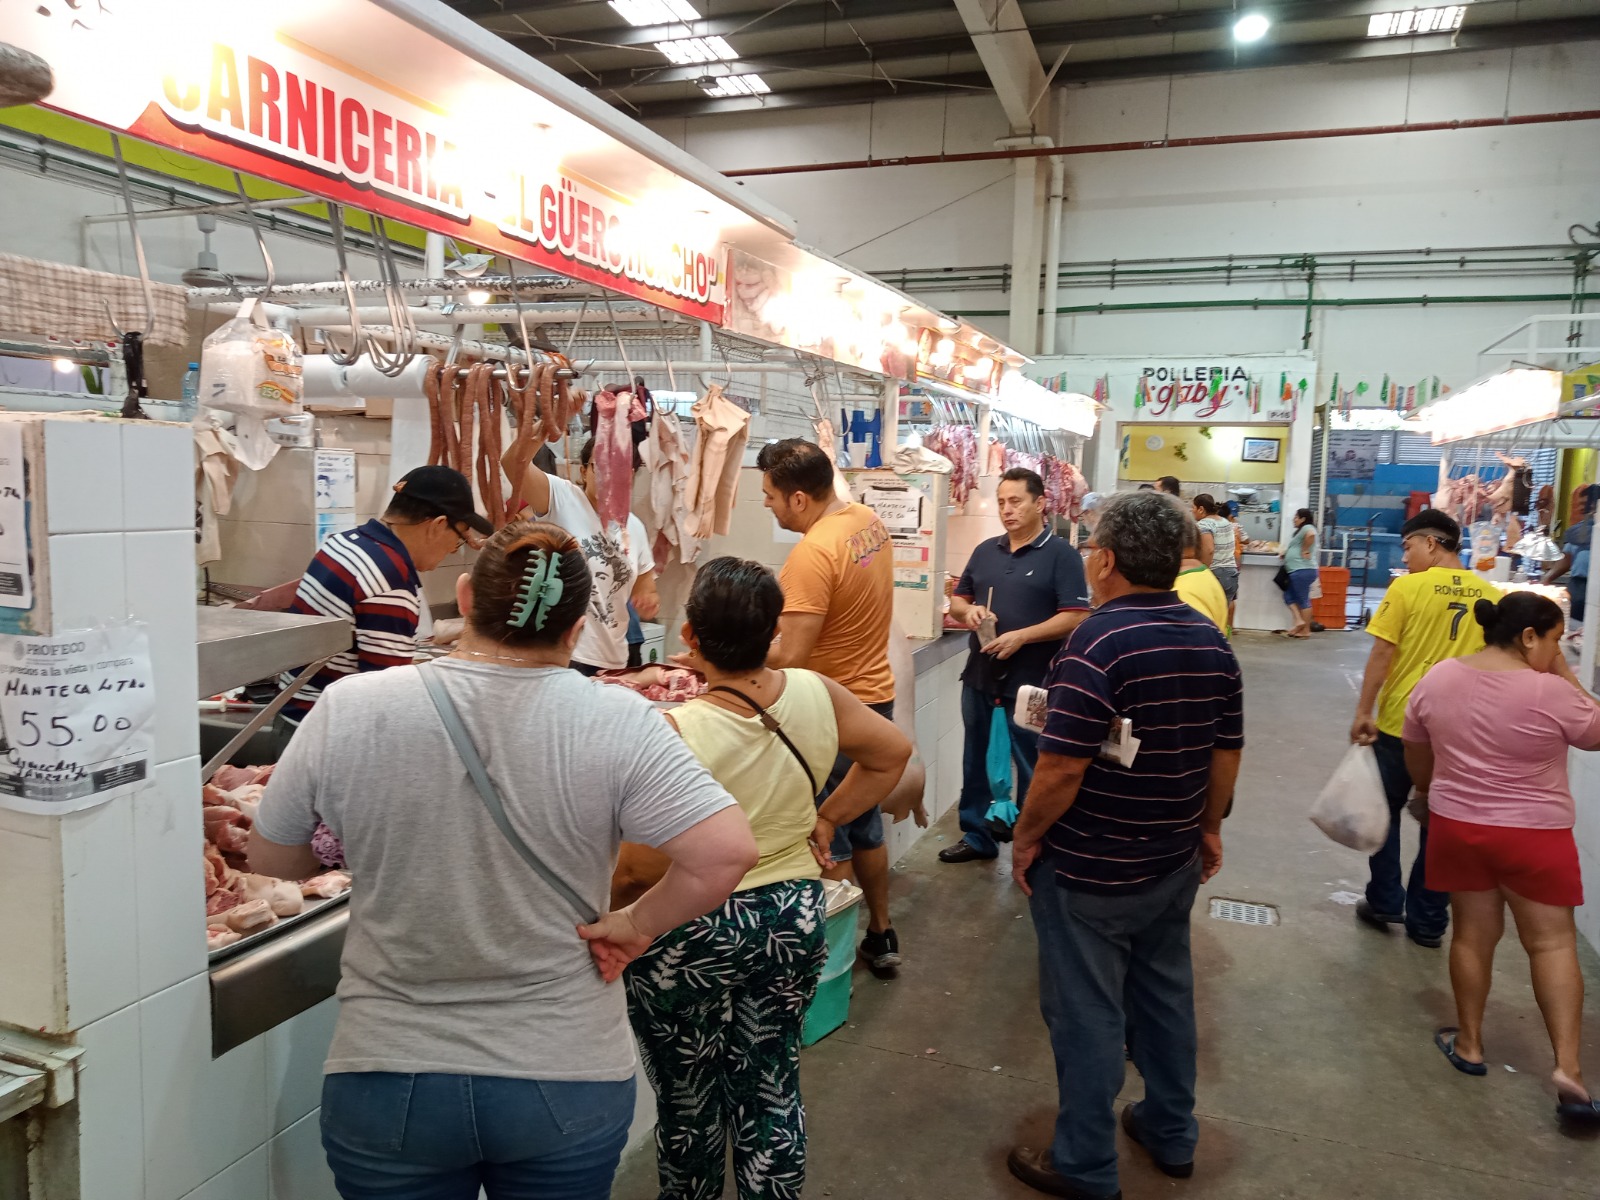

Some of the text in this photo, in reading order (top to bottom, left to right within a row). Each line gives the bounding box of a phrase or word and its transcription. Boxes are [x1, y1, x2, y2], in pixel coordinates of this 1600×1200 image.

[162, 42, 464, 210] CARNICERIA
[540, 177, 622, 268] GÜERO
[1143, 366, 1249, 382] POLLERIA
[1150, 382, 1233, 418] gaby
[1434, 585, 1483, 598] RONALDO
[1446, 601, 1469, 642] 7
[26, 642, 86, 656] PROFECO
[41, 668, 49, 677] a
[50, 667, 62, 677] la
[64, 663, 89, 676] vista
[96, 657, 135, 670] compara
[4, 678, 91, 698] MANTECA
[16, 710, 133, 747] 55.00
